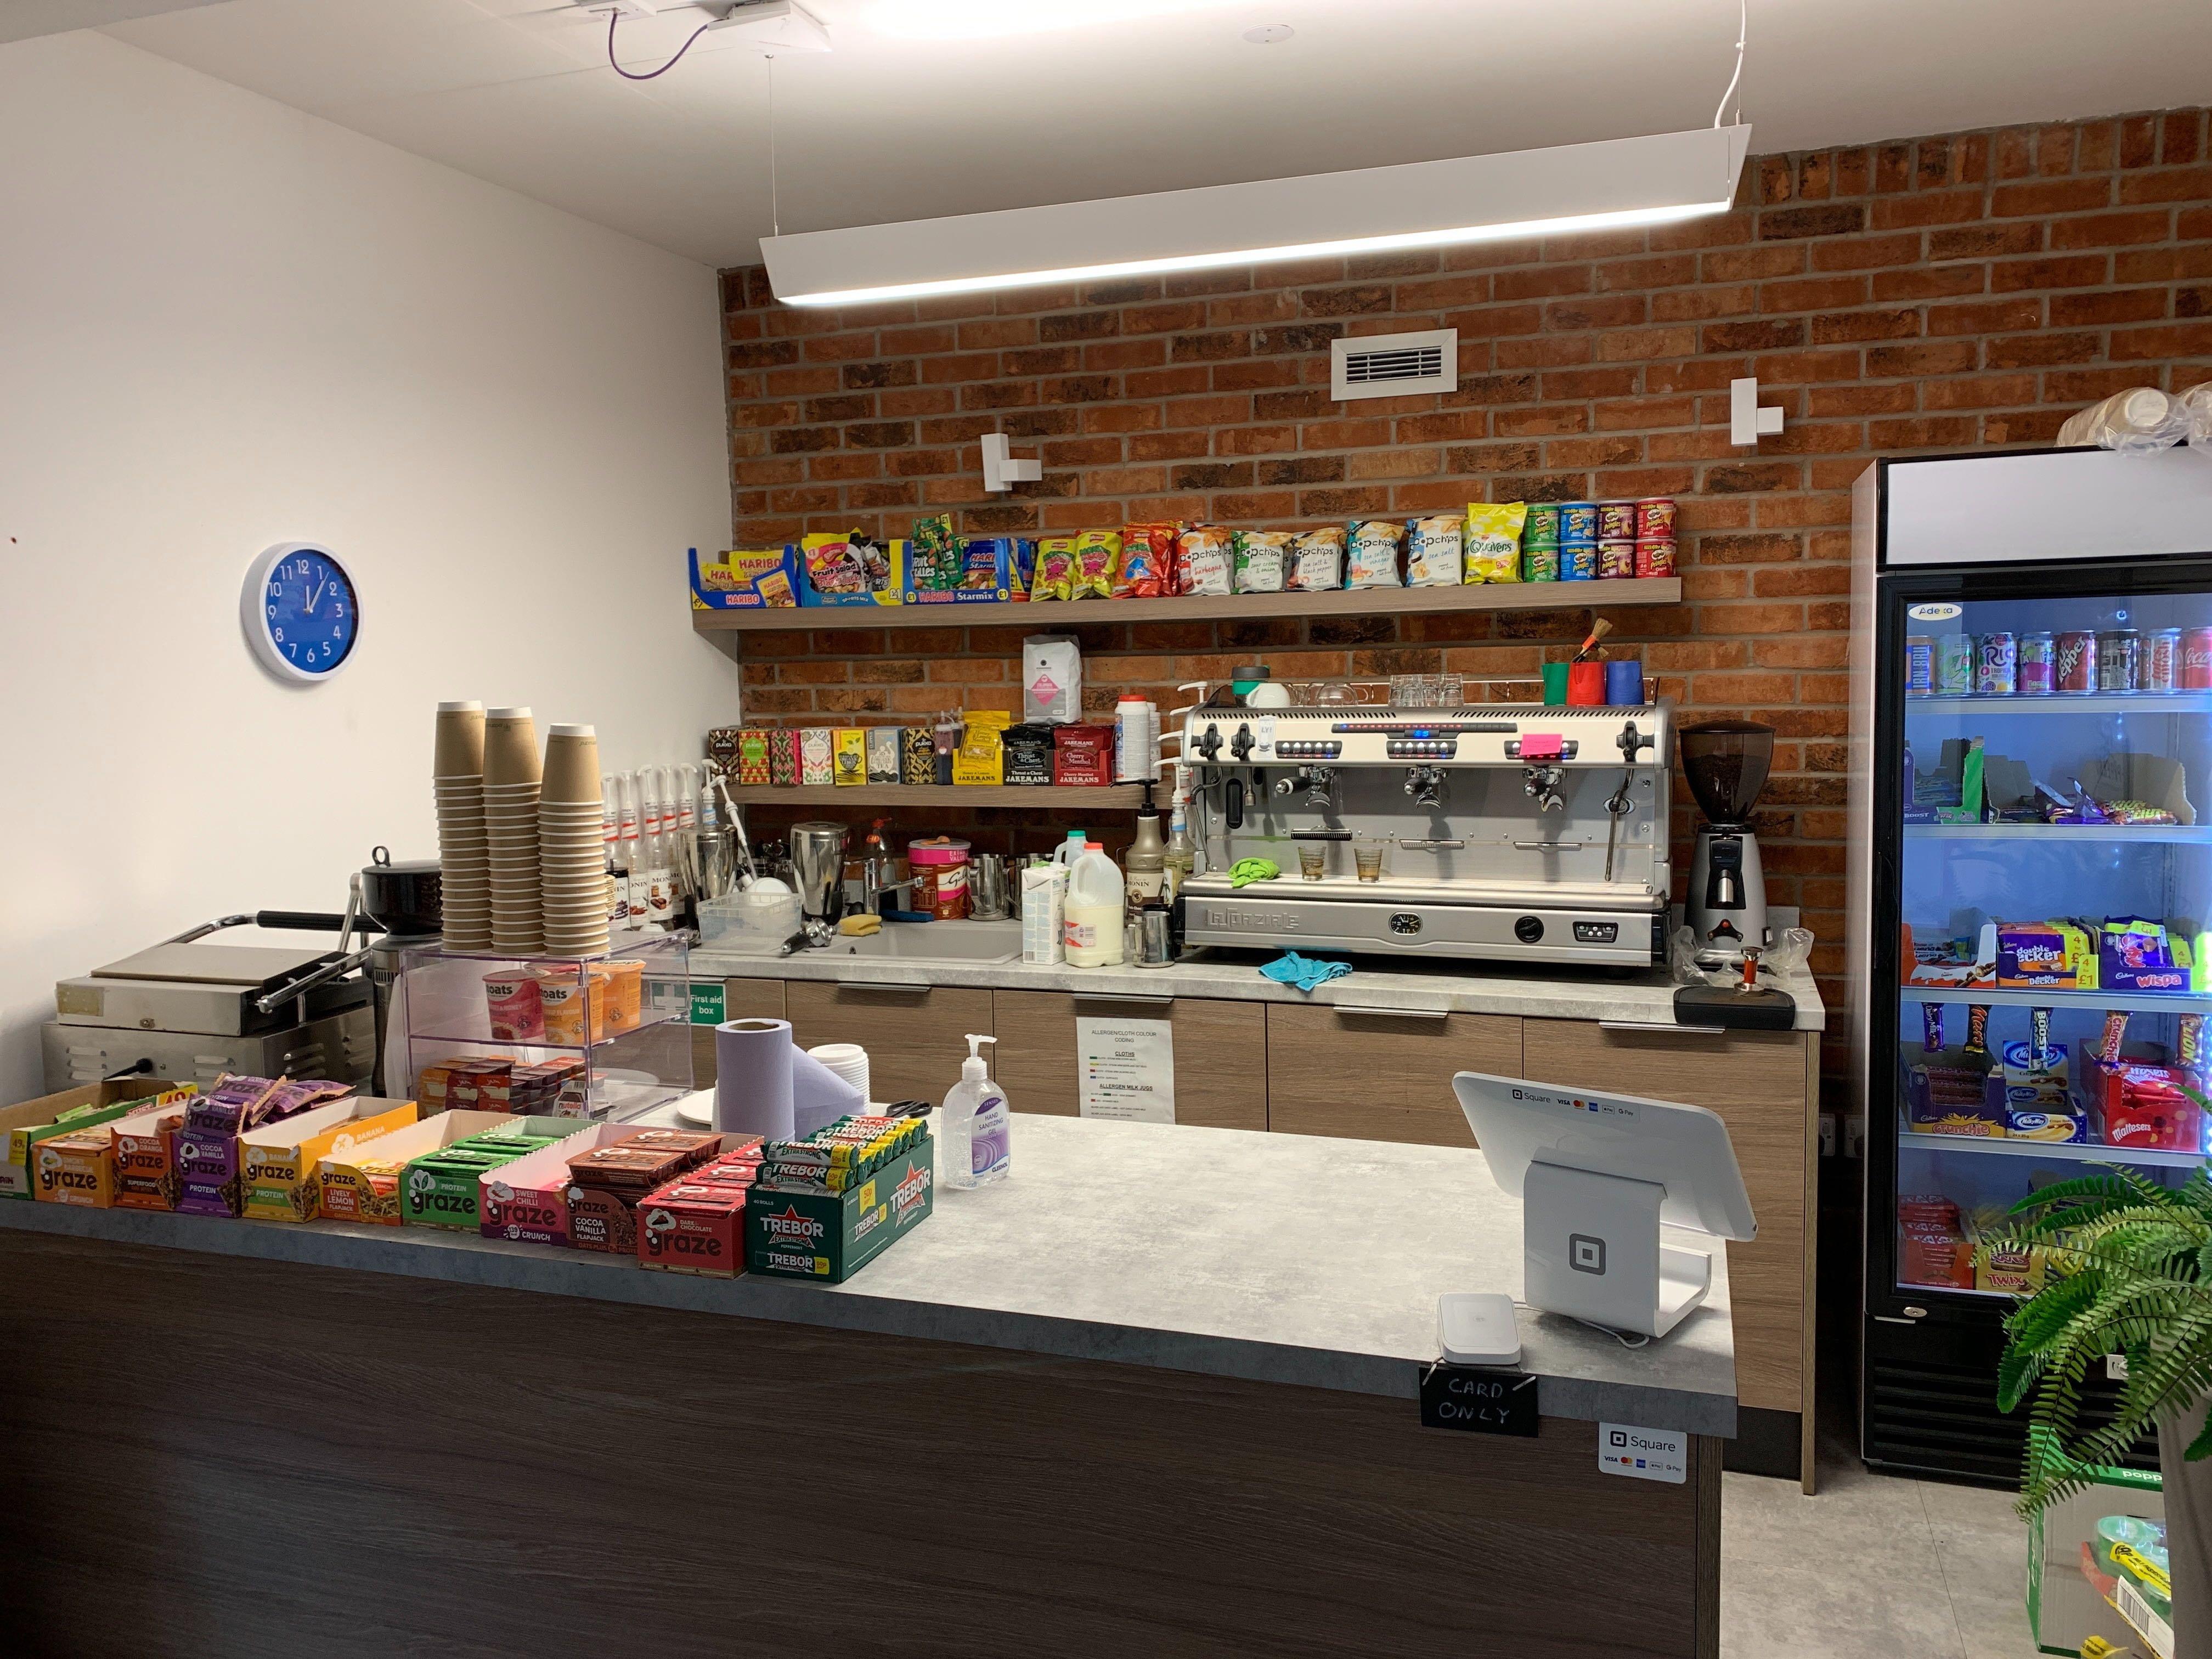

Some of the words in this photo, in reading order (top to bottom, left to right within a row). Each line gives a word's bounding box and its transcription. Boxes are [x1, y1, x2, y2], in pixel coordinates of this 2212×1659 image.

[1470, 539, 1511, 553] Quavers
[1180, 549, 1221, 565] popchips
[1240, 548, 1280, 559] popchips
[296, 560, 309, 574] 12
[739, 558, 782, 568] HARIBO
[1369, 557, 1390, 566] vinegar
[280, 566, 292, 580] 11
[317, 566, 323, 579] 1
[812, 567, 834, 577] Fruit
[835, 563, 856, 574] Salad
[1194, 565, 1222, 575] barbeque
[269, 582, 281, 597] 10
[329, 582, 337, 596] 2
[889, 588, 901, 600] £1
[726, 594, 759, 605] HARIBO
[918, 591, 955, 602] HARIBO
[957, 591, 994, 601] Starmix
[268, 605, 276, 619] 9
[335, 603, 343, 617] 3
[275, 628, 284, 642] 8
[333, 625, 341, 639] 4
[289, 644, 297, 658] 7
[307, 648, 315, 662] 6
[323, 642, 331, 656] 5
[2017, 945, 2050, 955] double
[2017, 950, 2061, 962] ecker
[2028, 978, 2061, 986] Decker
[2078, 974, 2094, 985] £1
[540, 989, 567, 999] toats
[690, 995, 708, 1003] First
[698, 1006, 714, 1014] box
[2037, 1010, 2047, 1051] BOOST
[2182, 1026, 2196, 1060] LION
[1524, 1092, 1551, 1103] Square
[211, 1105, 236, 1115] VANILLA
[985, 1112, 998, 1121] HAND
[979, 1118, 1003, 1131] SANITIZING
[357, 1126, 385, 1142] BANANA
[2112, 1124, 2152, 1143] Maltesers
[139, 1144, 163, 1153] ORANGE
[200, 1144, 223, 1152] COCOA
[799, 1149, 821, 1159] STRONG
[119, 1153, 164, 1170] graze
[201, 1151, 225, 1159] VANILLA
[181, 1159, 227, 1176] graze
[247, 1164, 295, 1181] graze
[772, 1163, 827, 1178] TREBOR
[992, 1163, 1008, 1173] CLEENOL
[41, 1169, 98, 1190] graze
[127, 1180, 156, 1188] SUPERFOOD
[321, 1171, 357, 1186] graze
[777, 1175, 794, 1183] EXTRA
[794, 1177, 816, 1186] STRONG
[189, 1184, 216, 1194] PROTEIN
[330, 1189, 351, 1197] LIVELY
[441, 1183, 467, 1192] PROTEIN
[516, 1189, 538, 1198] SWEET
[890, 1169, 931, 1213] TREBOR
[256, 1190, 284, 1199] PROTEIN
[327, 1195, 354, 1206] LEMON
[410, 1191, 476, 1215] graze
[516, 1197, 538, 1206] CHILLI
[568, 1200, 610, 1214] graze
[487, 1204, 557, 1226] graze
[575, 1217, 603, 1227] COCOA
[680, 1224, 712, 1233] CHOCOLATE
[760, 1217, 824, 1237] TREBOR
[855, 1209, 879, 1235] TREBOR
[575, 1224, 606, 1235] VANILLA
[522, 1231, 551, 1242] CRUNCH
[577, 1234, 604, 1242] FLAPJACK
[646, 1233, 722, 1257] graze
[767, 1251, 813, 1268] TREBOR
[1987, 1273, 2025, 1287] Twix
[1449, 1378, 1503, 1398] CARD
[1438, 1402, 1510, 1424] ONLY
[1630, 1436, 1676, 1452] Square
